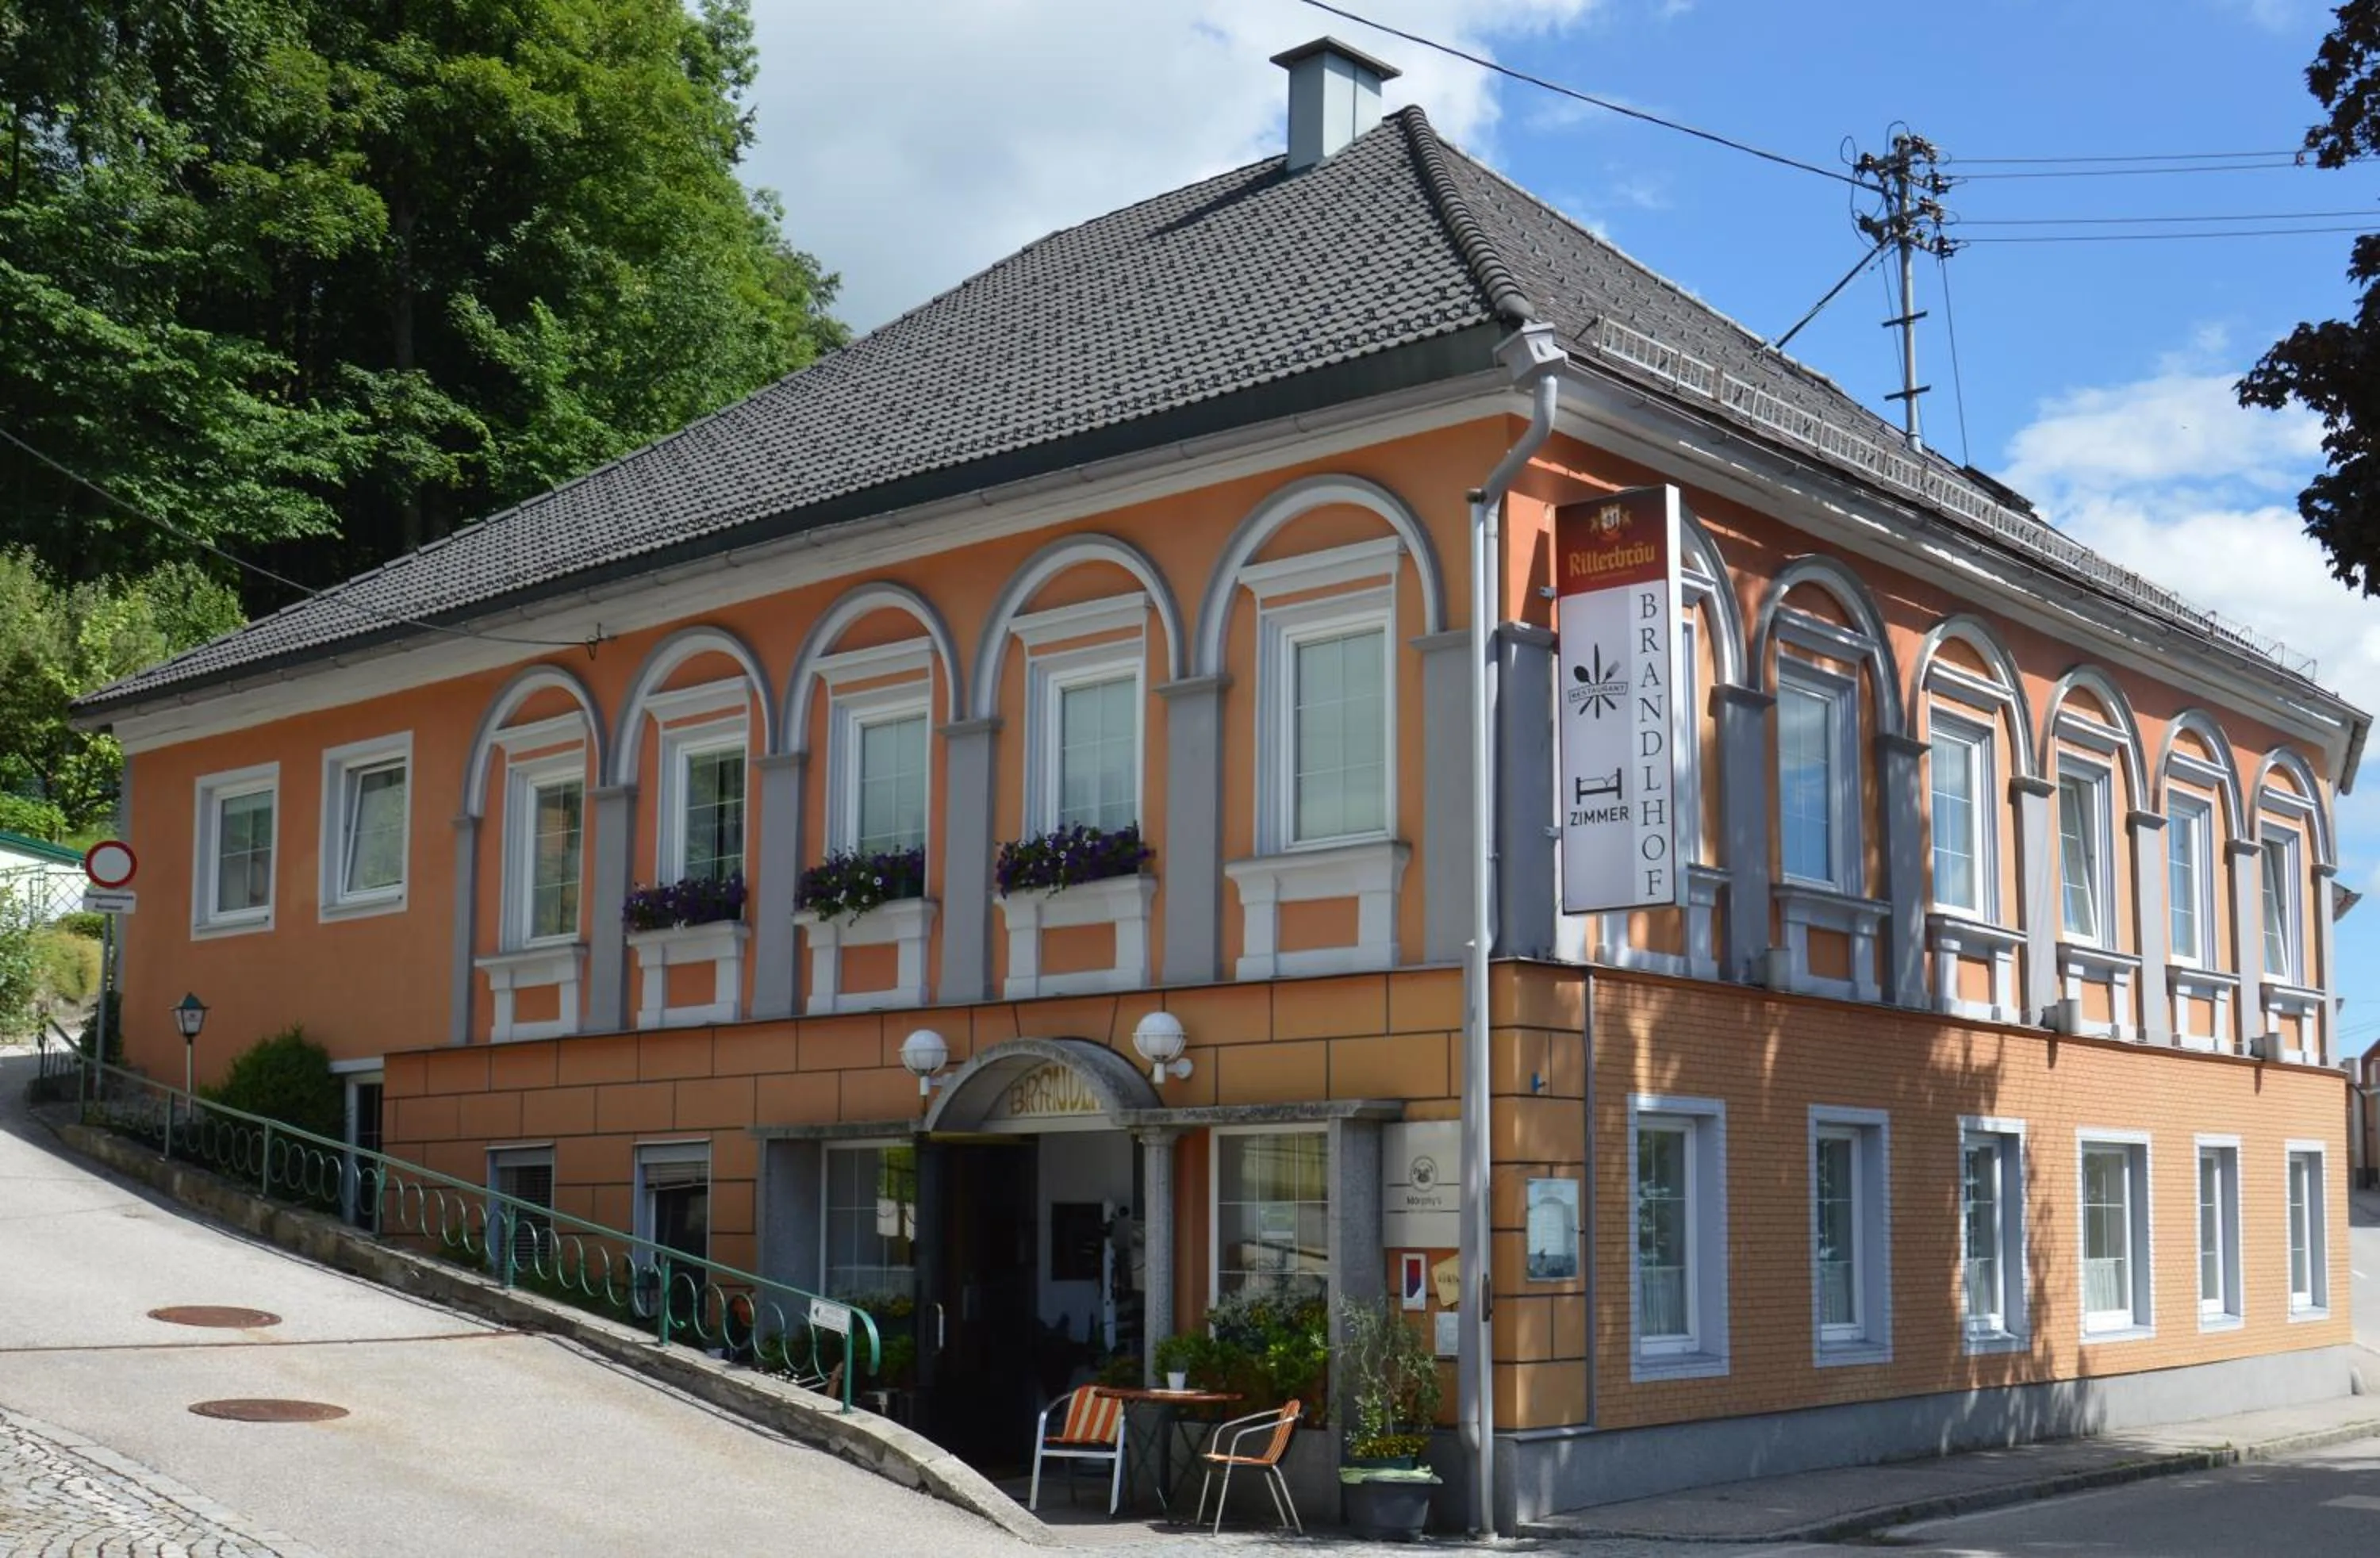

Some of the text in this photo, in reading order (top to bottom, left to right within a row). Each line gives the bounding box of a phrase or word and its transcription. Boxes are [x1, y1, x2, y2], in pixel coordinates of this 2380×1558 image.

[1569, 541, 1655, 578] Ritterbräu
[1571, 684, 1626, 698] RESTAURANT
[1639, 593, 1665, 896] BRANDLHOF
[1570, 805, 1630, 826] ZIMMER
